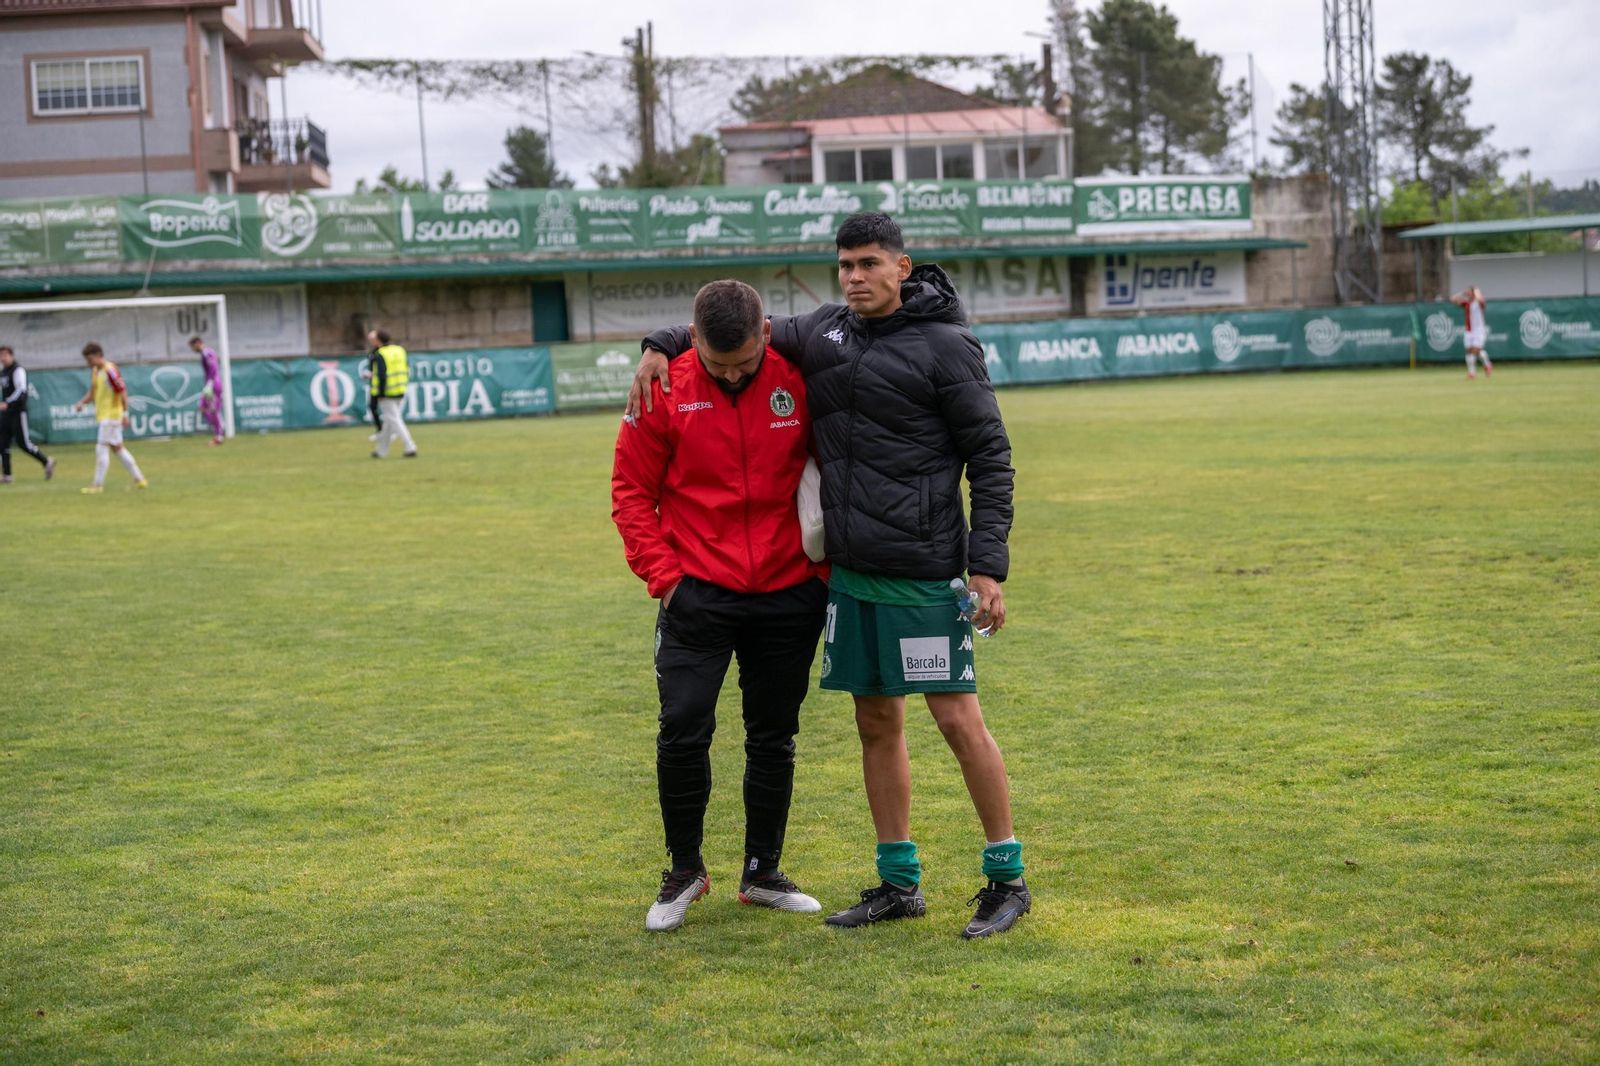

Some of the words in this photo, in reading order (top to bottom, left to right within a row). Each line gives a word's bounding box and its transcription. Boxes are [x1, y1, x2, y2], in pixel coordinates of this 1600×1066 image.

[443, 193, 490, 214] BAR
[1118, 186, 1242, 213] PRECASA
[415, 218, 521, 242] SOLDADO
[1019, 337, 1102, 363] ABANCA
[1117, 332, 1200, 357] ABANCA
[678, 401, 714, 412] Kappa
[131, 411, 209, 436] UCHEL
[770, 419, 800, 429] ABANCA
[906, 654, 946, 669] Barcala
